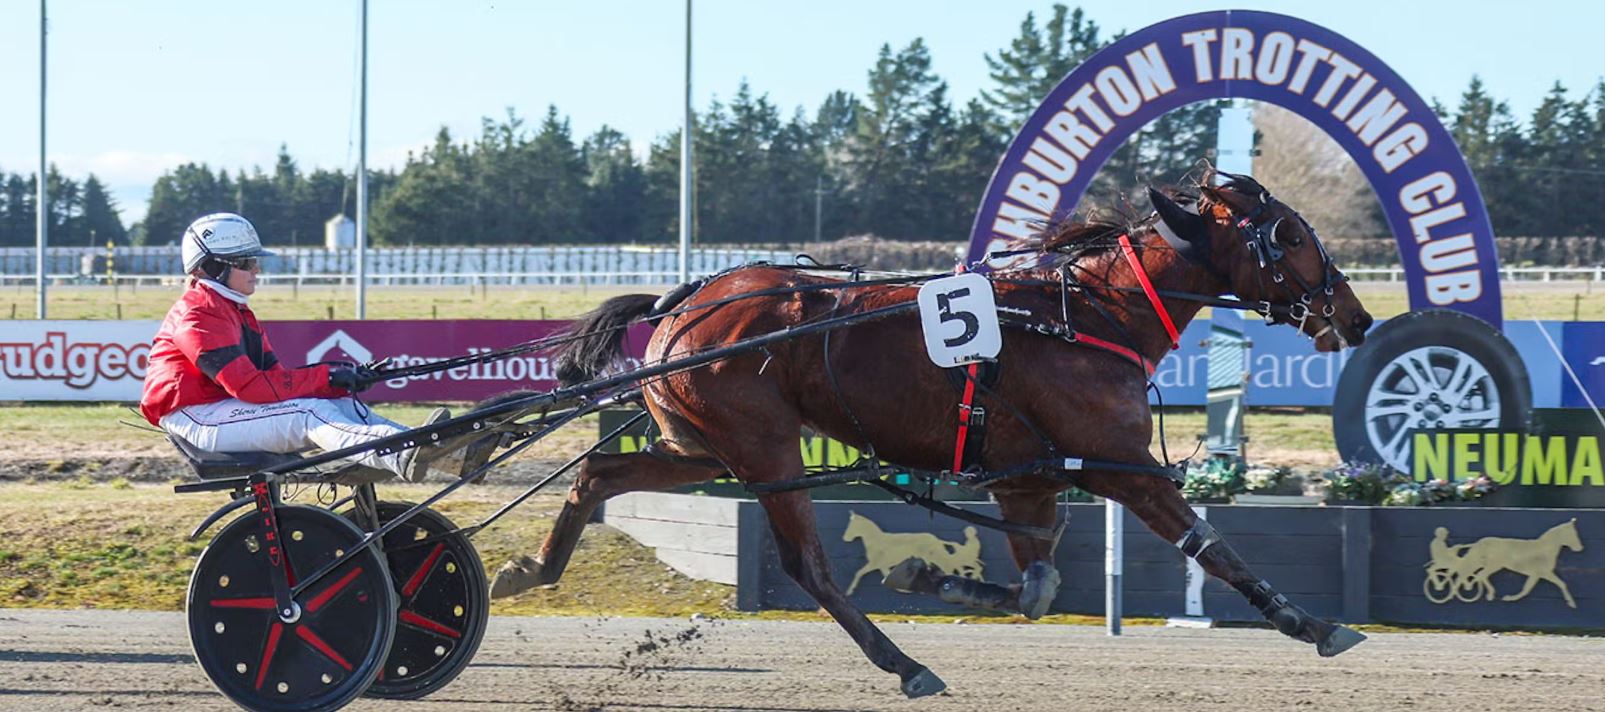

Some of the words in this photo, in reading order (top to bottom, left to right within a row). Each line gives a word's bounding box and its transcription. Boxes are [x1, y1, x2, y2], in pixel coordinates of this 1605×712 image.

[986, 42, 1177, 269] SHBURTON
[1182, 27, 1428, 174] TROTTING
[1400, 171, 1482, 306] CLUB
[936, 287, 979, 347] 5
[0, 331, 149, 389] udgeo
[384, 347, 557, 388] gavelhou
